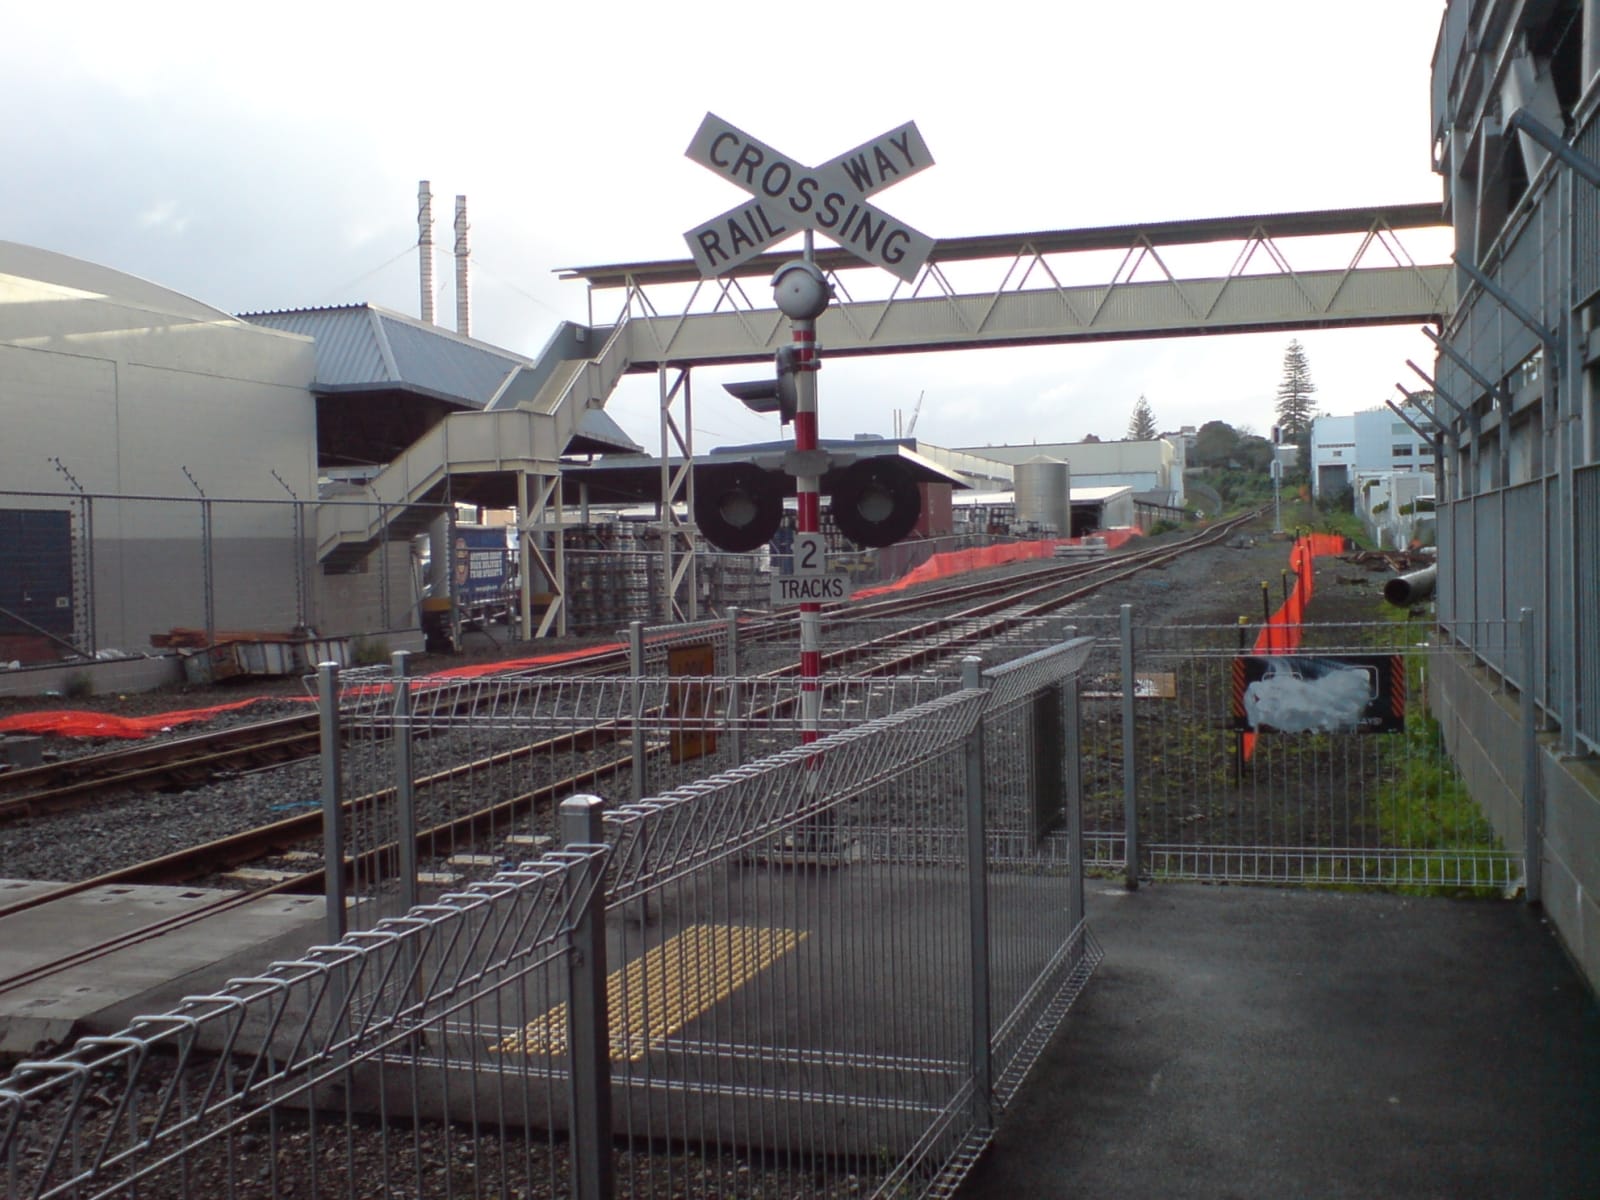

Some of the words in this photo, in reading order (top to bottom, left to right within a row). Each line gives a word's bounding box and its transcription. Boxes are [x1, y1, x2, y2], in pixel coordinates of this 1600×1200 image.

[697, 204, 786, 267] RAIL
[842, 131, 915, 192] WAY
[709, 131, 911, 265] CROSSING
[779, 578, 844, 599] TRACKS
[801, 540, 817, 569] 2
